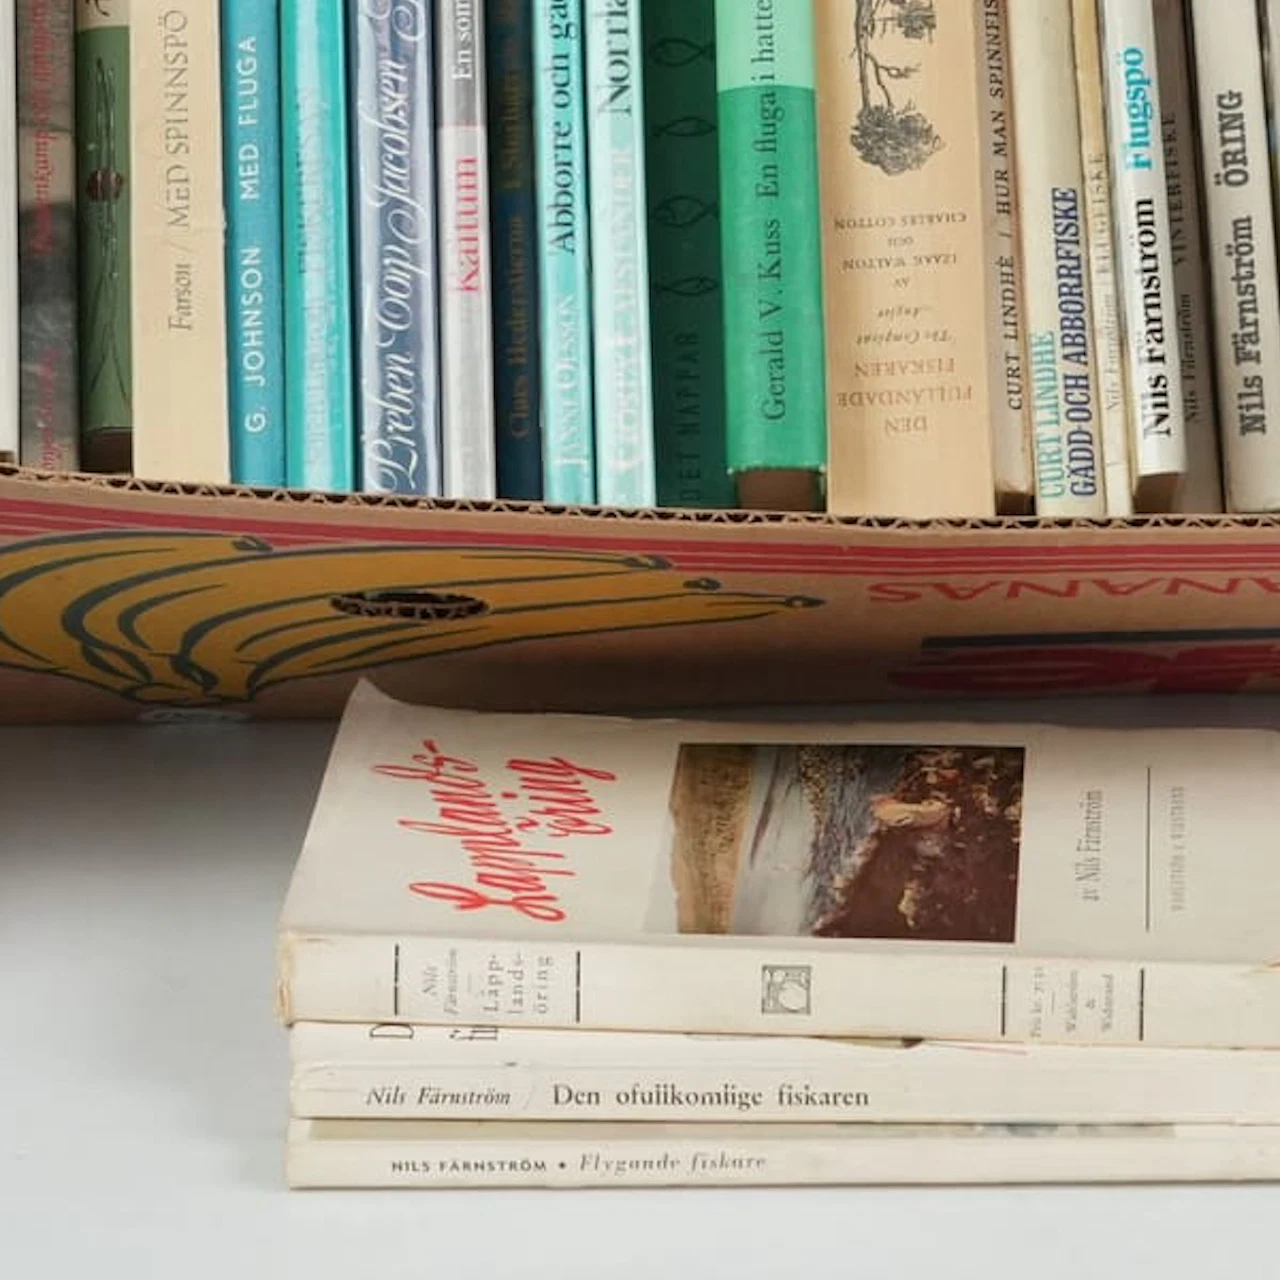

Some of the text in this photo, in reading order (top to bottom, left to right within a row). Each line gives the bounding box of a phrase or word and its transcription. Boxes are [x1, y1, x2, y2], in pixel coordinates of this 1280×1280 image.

[159, 8, 191, 156] SPINNSPÖ
[451, 47, 473, 81] En
[360, 57, 419, 244] Jacobsen
[540, 52, 577, 256] Abborre och
[751, 90, 786, 154] fluga
[990, 110, 1008, 157] MAN
[164, 164, 191, 231] MED
[754, 163, 781, 200] En
[993, 168, 1012, 215] HUR
[1160, 111, 1188, 267] VINTERFISKE
[236, 35, 267, 434] G. JOHNSON MED FLUGA
[451, 156, 480, 293] Kaitum
[756, 219, 783, 281] Kuss
[1116, 46, 1173, 440] Nils Färnström Flugspö
[167, 261, 194, 332] Farson
[1215, 89, 1268, 437] Nils Färnström ÖRING
[758, 289, 783, 320] V.
[1050, 186, 1094, 421] OCH ABBORRFISKE
[755, 329, 787, 421] Gerald
[853, 358, 955, 378] FISKAREN
[1004, 351, 1023, 411] CURT
[362, 351, 419, 494] Preben
[884, 416, 929, 437] DEN
[1034, 432, 1065, 499] CURT
[1075, 856, 1099, 882] Nils
[366, 1083, 870, 1108] Nils Färnström Den fiskaren
[391, 1150, 768, 1176] NILS FÄRNSTRÖM Flygande fiskare
